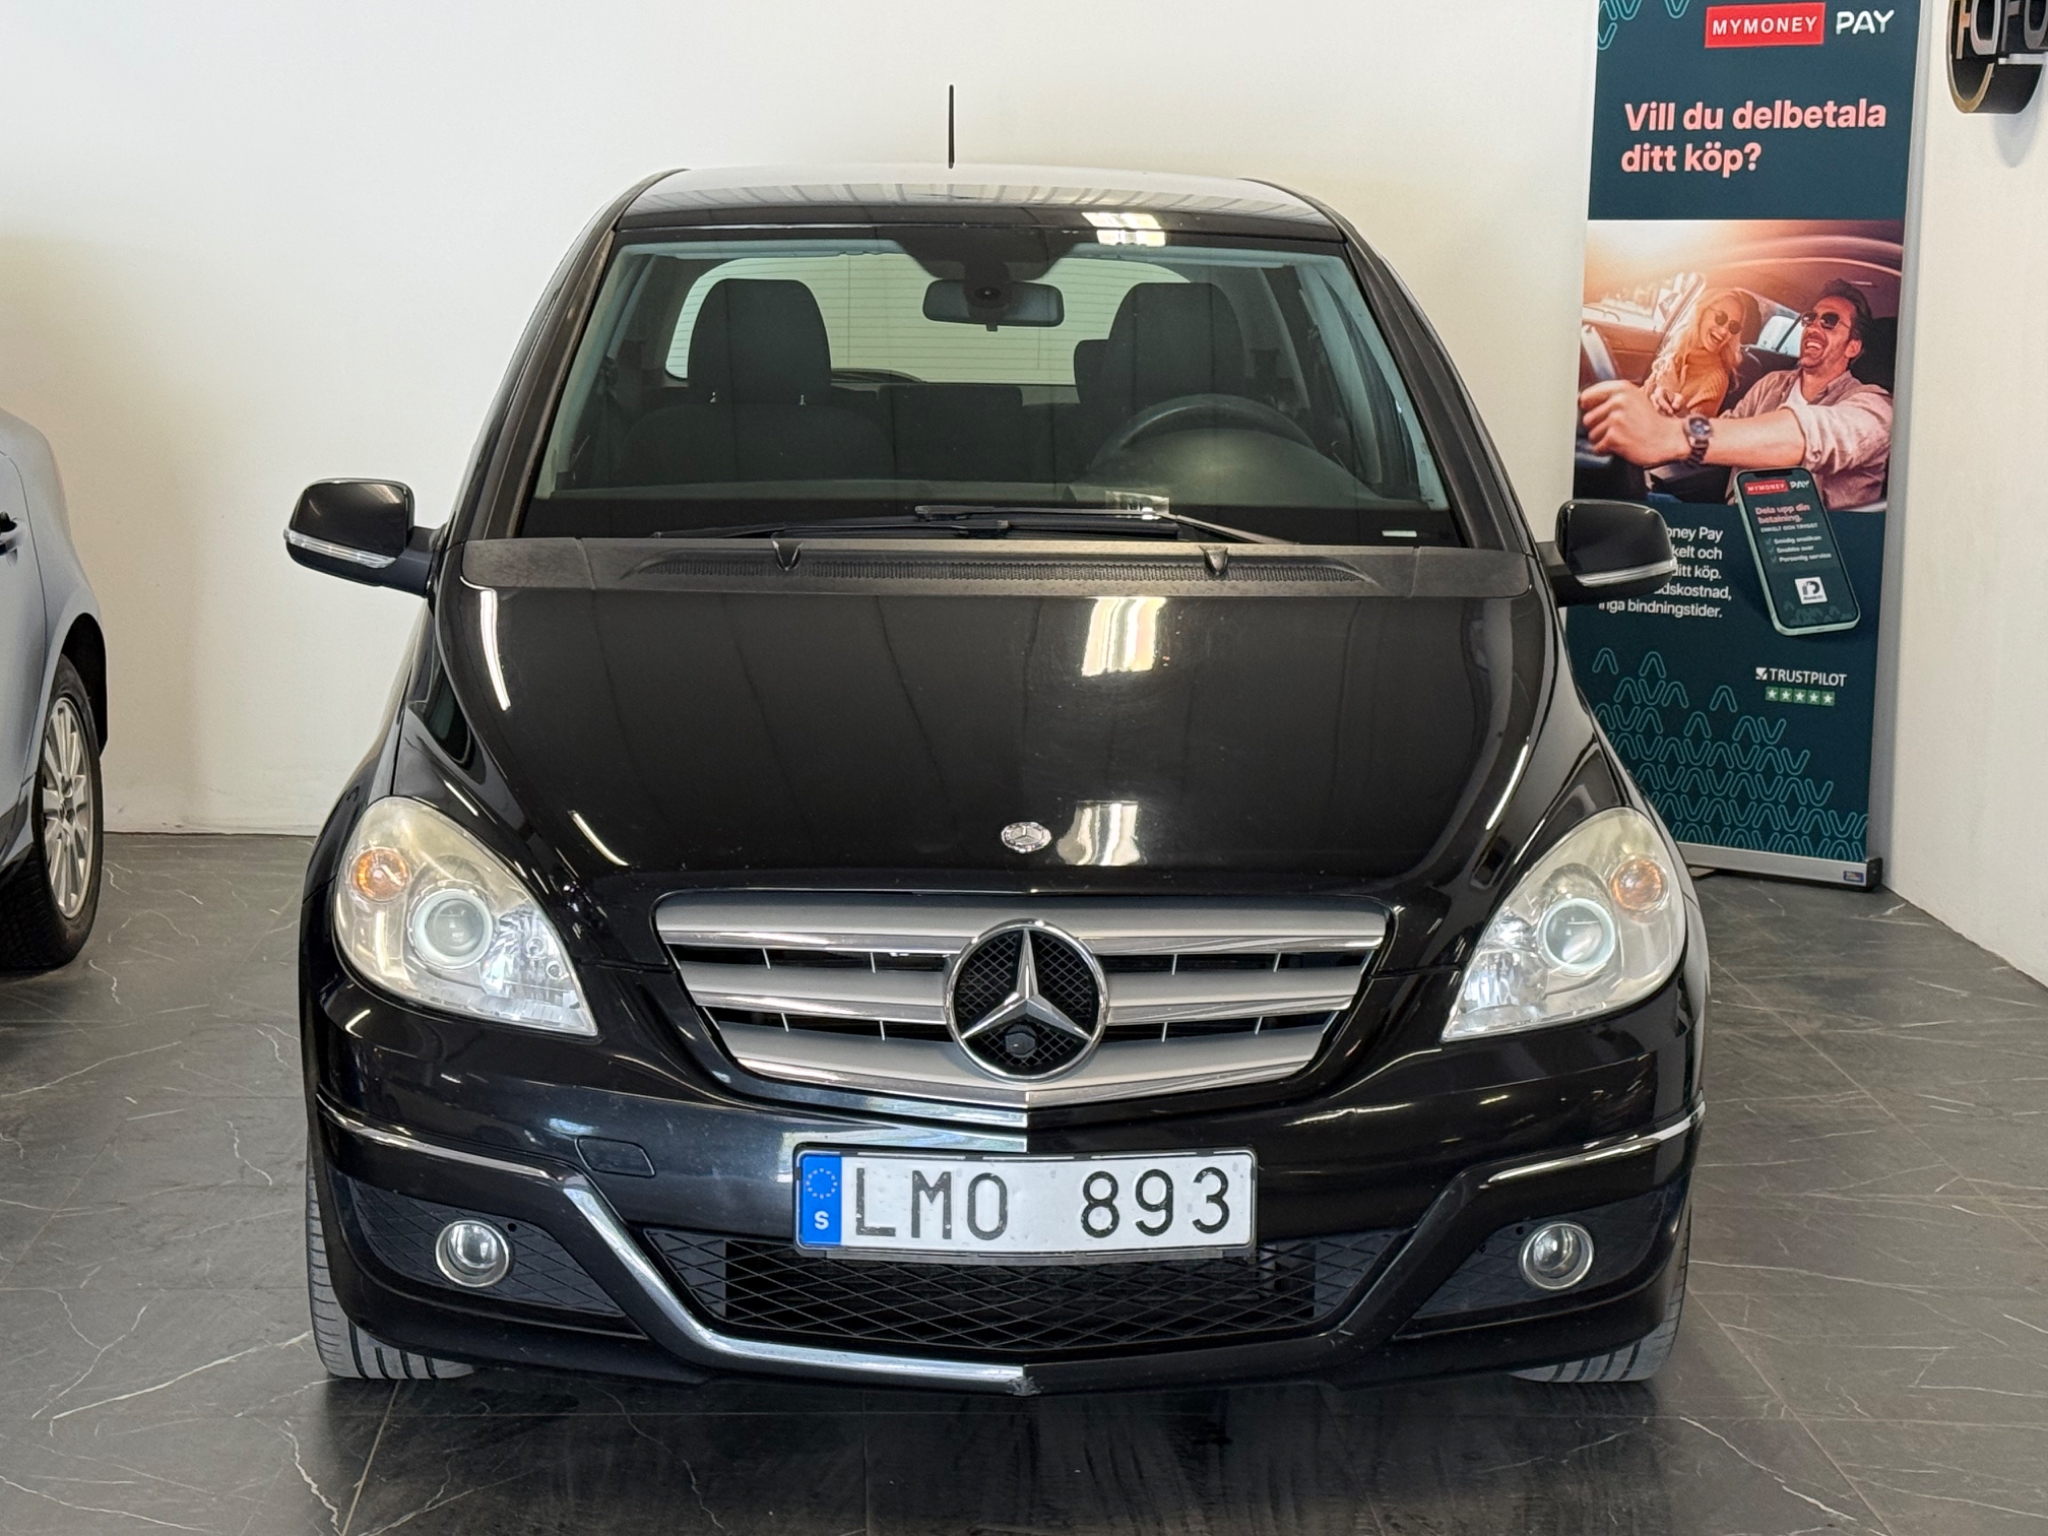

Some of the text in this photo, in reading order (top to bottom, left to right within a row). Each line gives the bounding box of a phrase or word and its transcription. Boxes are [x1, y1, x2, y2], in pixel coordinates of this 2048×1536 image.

[1712, 10, 1895, 36] MYMONEY PAY
[1625, 98, 1886, 131] Vill du delbetala
[1621, 142, 1762, 178] ditt köp?
[1790, 480, 1810, 490] PAY
[1699, 526, 1724, 543] Pay
[1697, 547, 1722, 560] och
[1694, 565, 1722, 581] köp.
[1627, 599, 1723, 618] bindningstider.
[1769, 668, 1848, 687] TRUSTPILOT
[855, 1166, 1231, 1241] LMO 893
[814, 1211, 830, 1230] S
